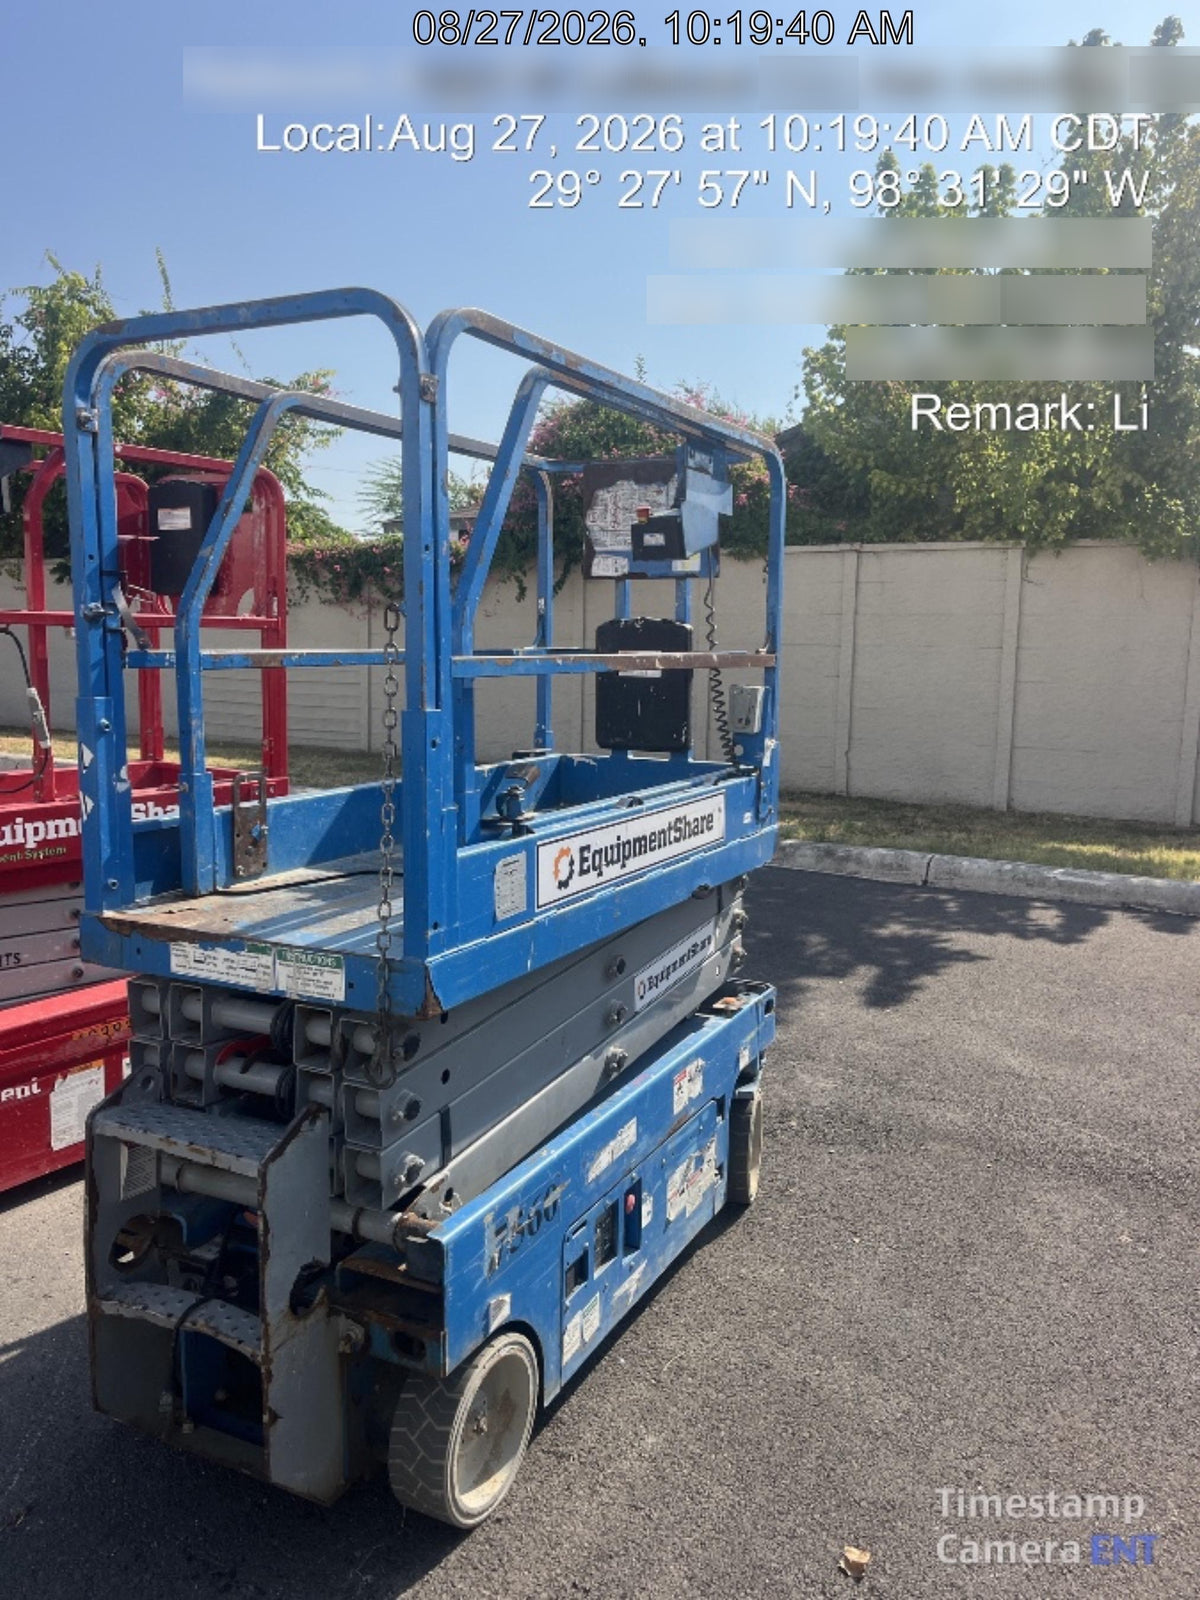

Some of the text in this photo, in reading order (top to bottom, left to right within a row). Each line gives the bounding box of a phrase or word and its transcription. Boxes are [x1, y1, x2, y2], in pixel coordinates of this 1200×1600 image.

[0, 801, 180, 849] uipm Sha
[577, 811, 714, 878] EquipmentShare
